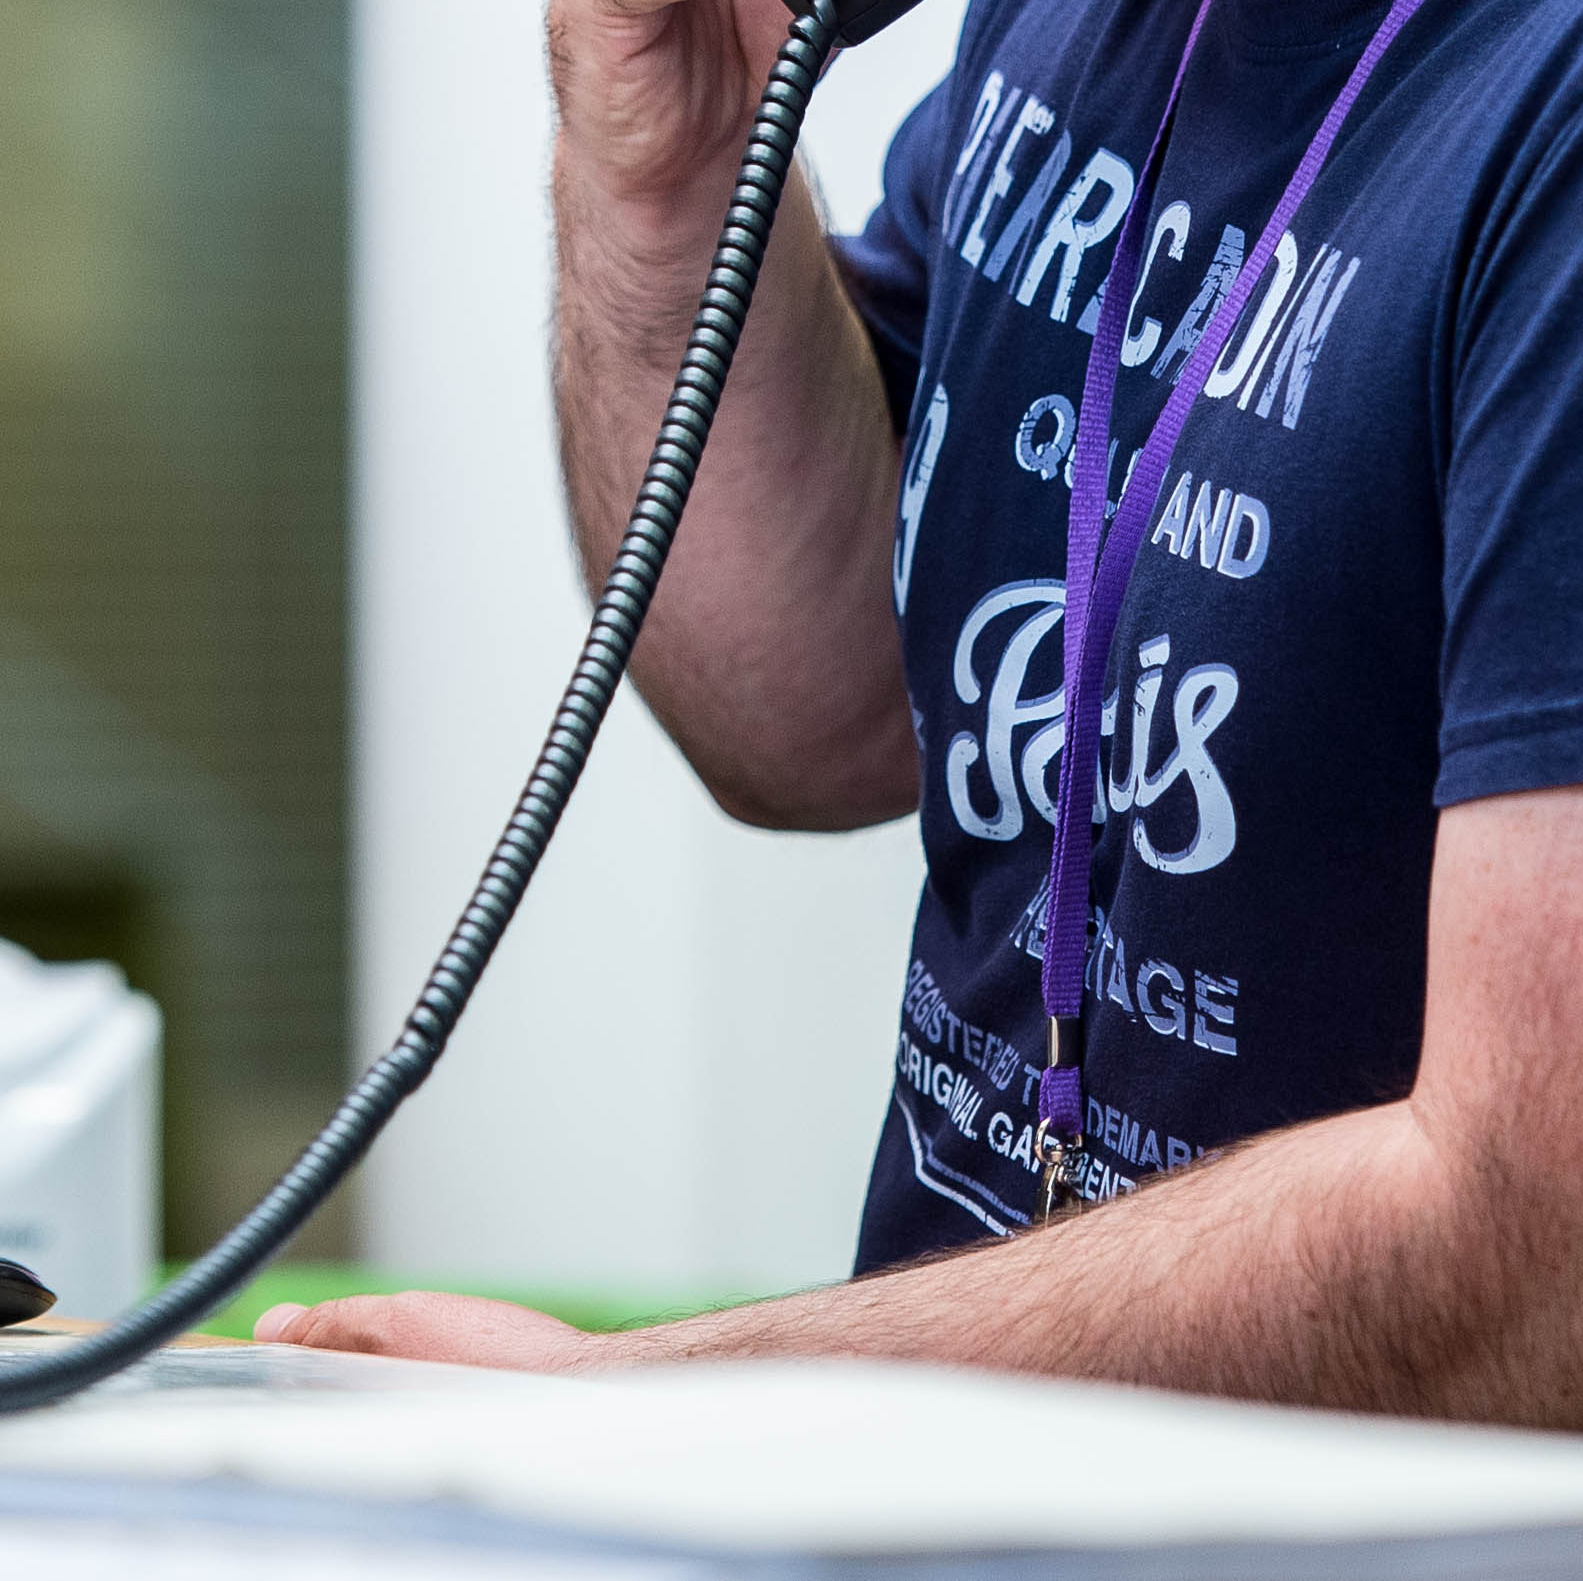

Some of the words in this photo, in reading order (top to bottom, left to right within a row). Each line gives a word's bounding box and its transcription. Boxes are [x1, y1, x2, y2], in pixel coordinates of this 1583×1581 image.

[1120, 200, 1362, 431] CADIN
[1151, 470, 1270, 579] AND
[898, 1031, 983, 1141] ORIGINAL
[904, 959, 1020, 1092] REGISTERED
[1022, 1063, 1210, 1175] TDEMAR
